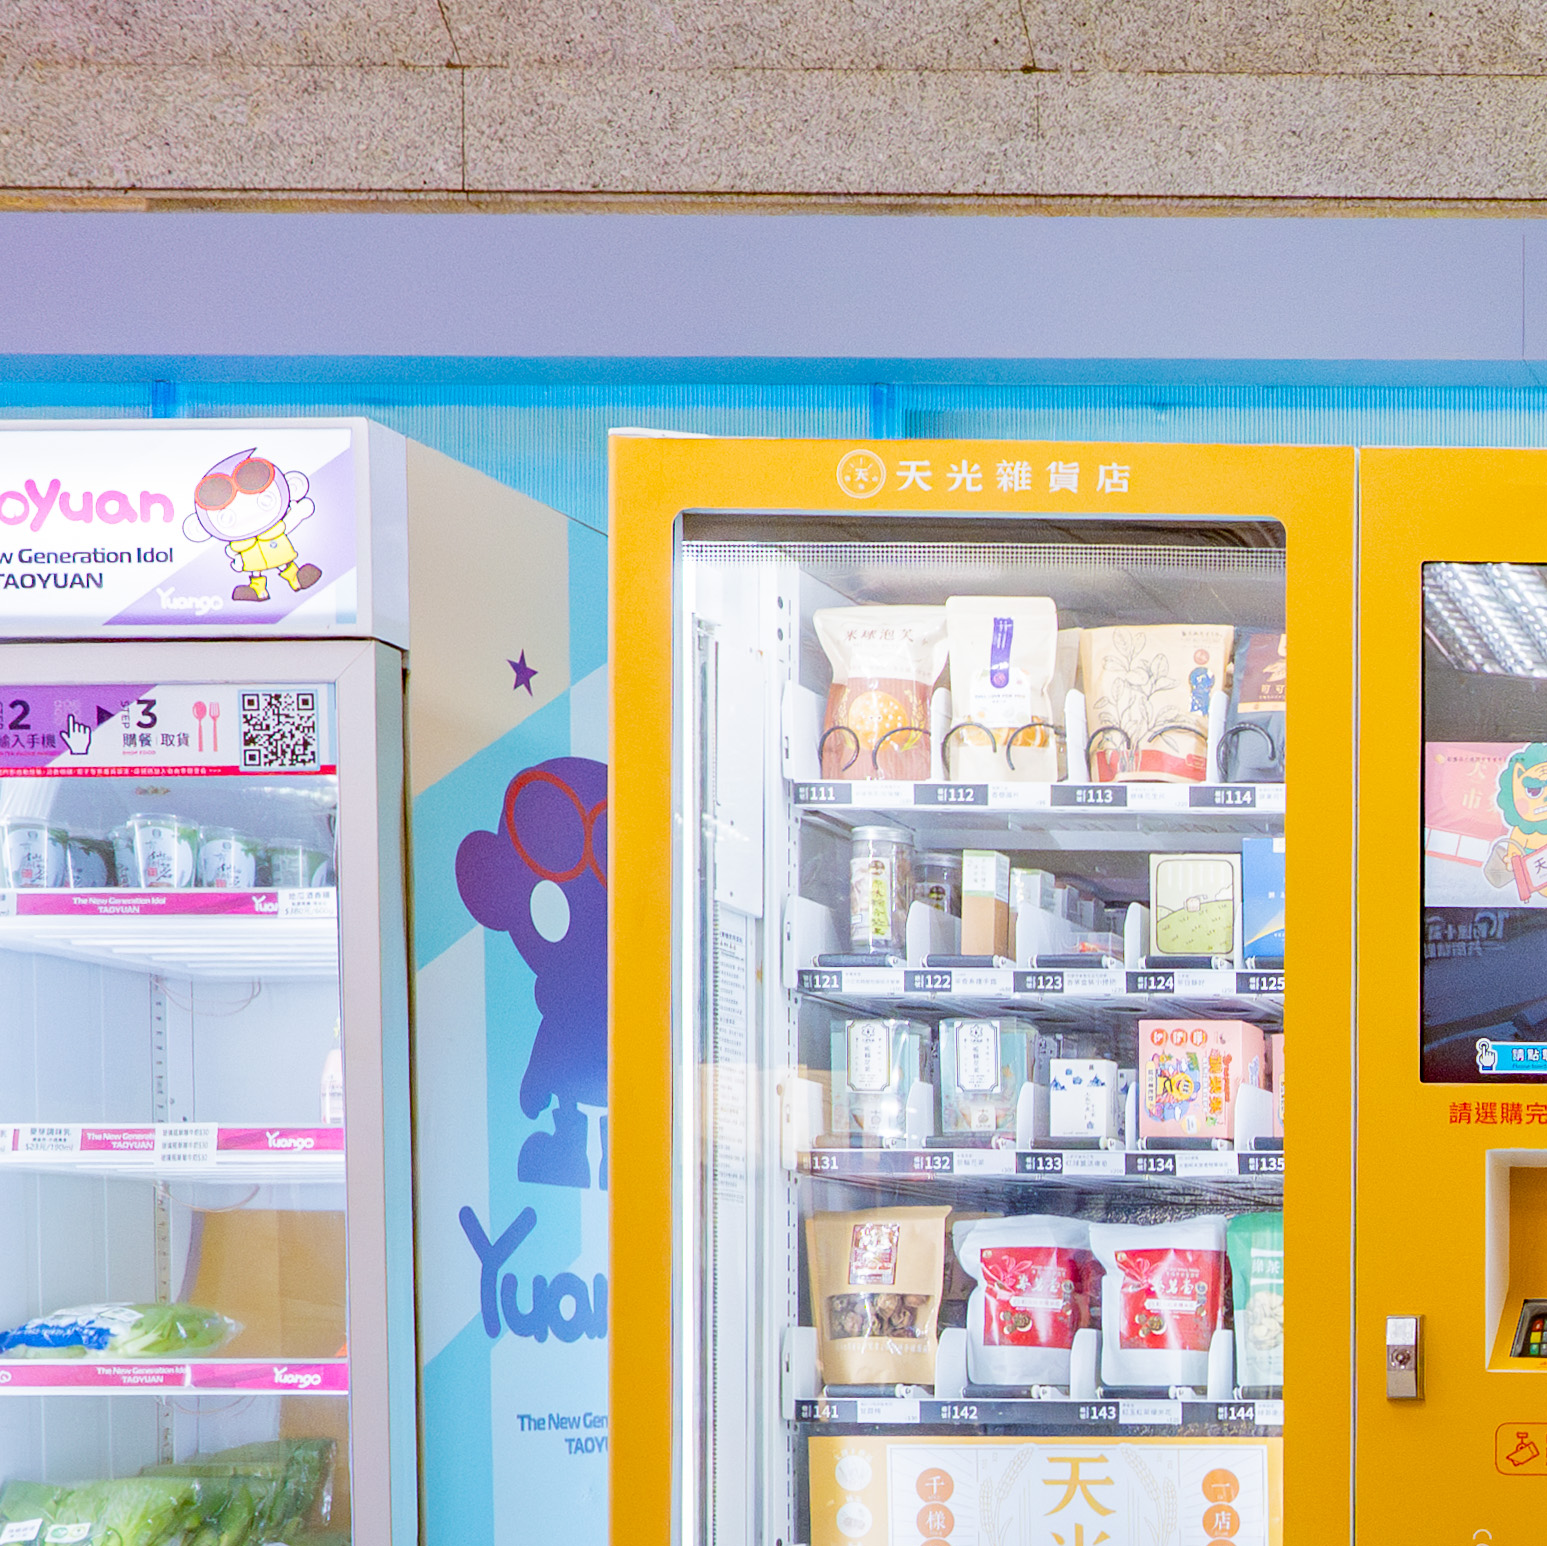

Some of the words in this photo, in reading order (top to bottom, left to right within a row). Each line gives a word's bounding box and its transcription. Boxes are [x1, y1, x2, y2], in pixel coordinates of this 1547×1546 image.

[897, 458, 1131, 493] 天光雜貨店
[18, 548, 132, 564] Generation
[137, 547, 173, 563] Idol
[156, 586, 224, 616] Yuango
[9, 700, 31, 730] 2
[136, 699, 157, 729] 3
[122, 733, 152, 748] 購餐
[161, 733, 190, 748] 取貨
[810, 787, 836, 801] 111
[949, 788, 974, 802] 112
[1087, 789, 1113, 803] 113
[1225, 790, 1252, 804] 114
[813, 975, 839, 988] 121
[925, 975, 951, 988] 122
[1037, 976, 1063, 989] 123
[1148, 976, 1174, 990] 124
[1260, 976, 1285, 990] 125
[266, 1131, 314, 1150] Yuango
[812, 1156, 839, 1170] 131
[924, 1156, 951, 1170] 132
[1036, 1157, 1062, 1170] 133
[1148, 1157, 1174, 1171] 134
[1259, 1157, 1284, 1171] 135
[273, 1367, 322, 1387] Yuango
[813, 1405, 839, 1419] 141
[952, 1406, 978, 1419] 142
[1090, 1406, 1117, 1420] 143
[1228, 1406, 1254, 1420] 144
[517, 1413, 545, 1432] The
[548, 1413, 580, 1432] New
